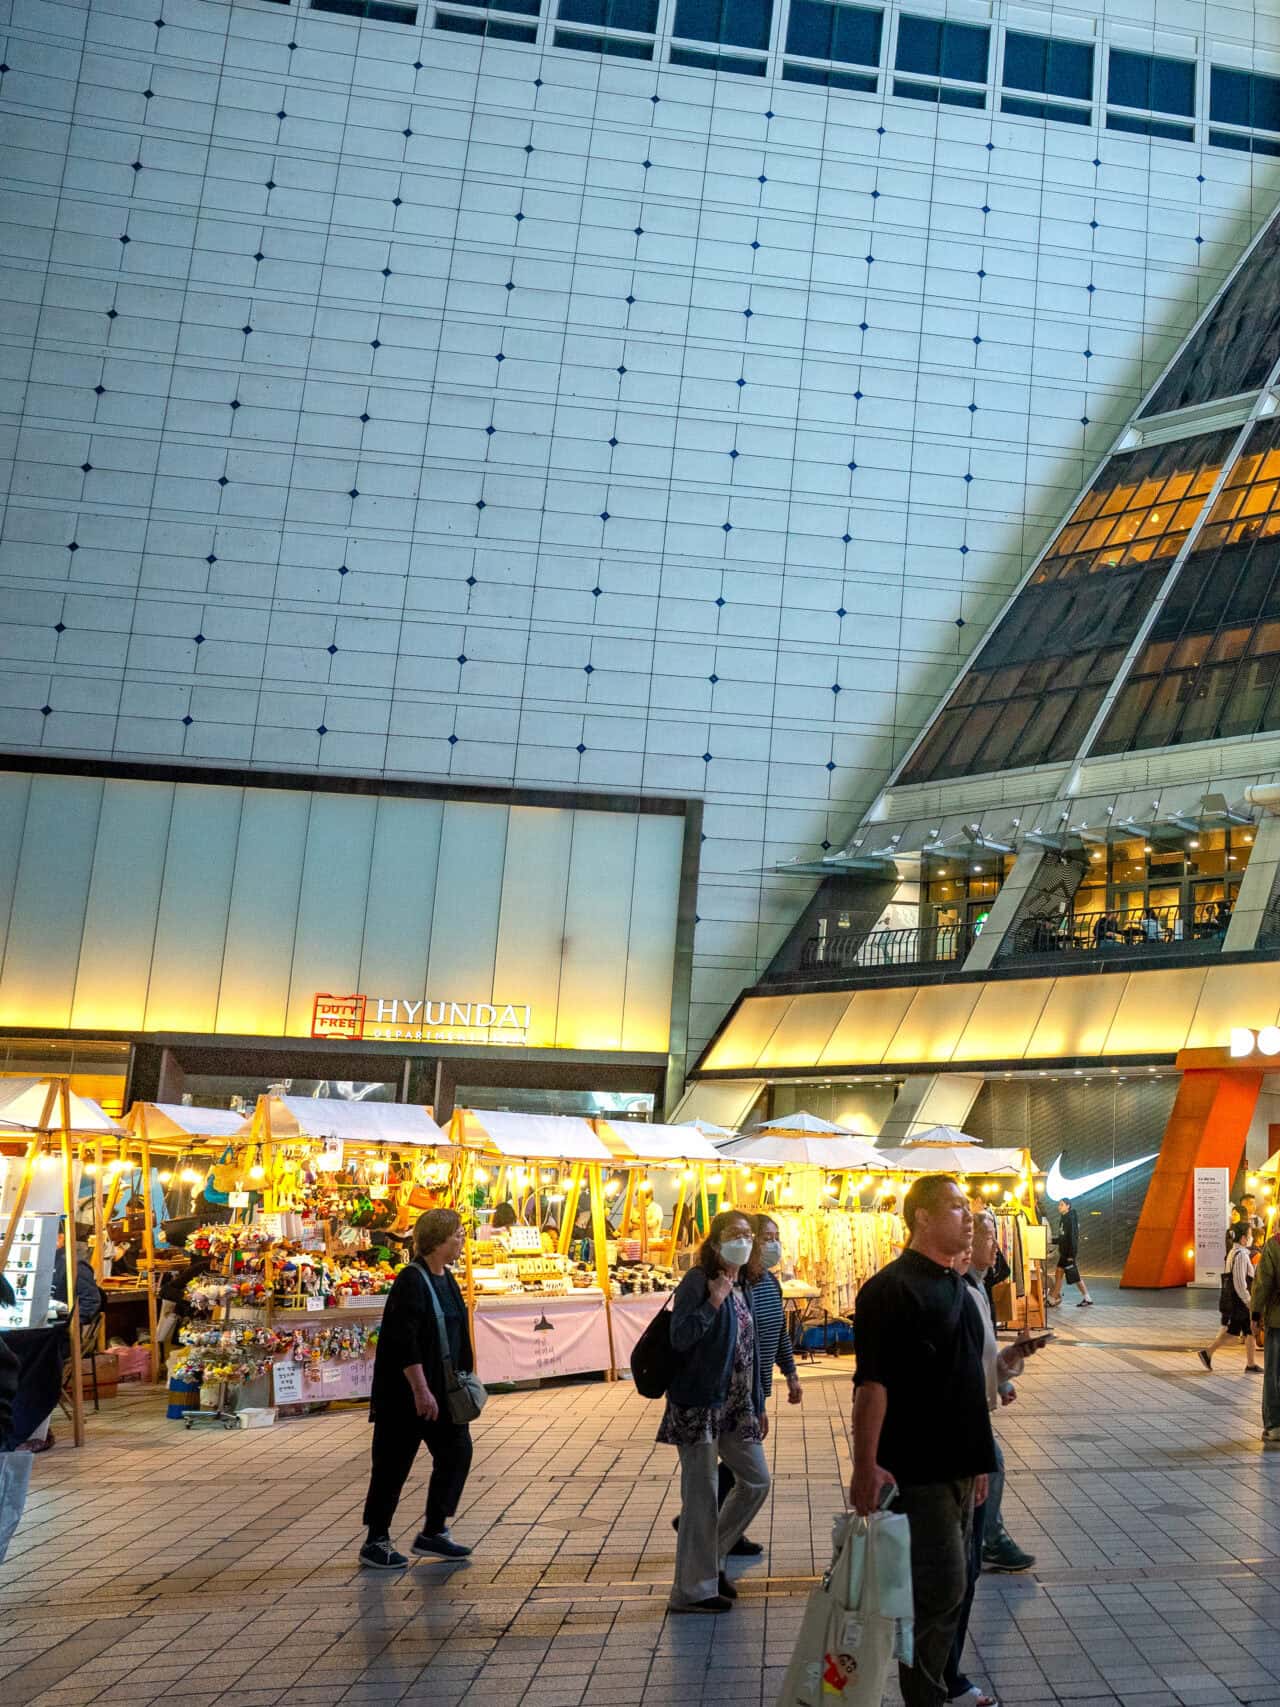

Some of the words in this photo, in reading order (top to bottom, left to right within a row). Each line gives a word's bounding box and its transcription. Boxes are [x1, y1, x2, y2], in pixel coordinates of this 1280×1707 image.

[321, 1005, 356, 1016] DUTY
[377, 999, 532, 1028] HYUNDAI
[320, 1018, 356, 1028] FREE
